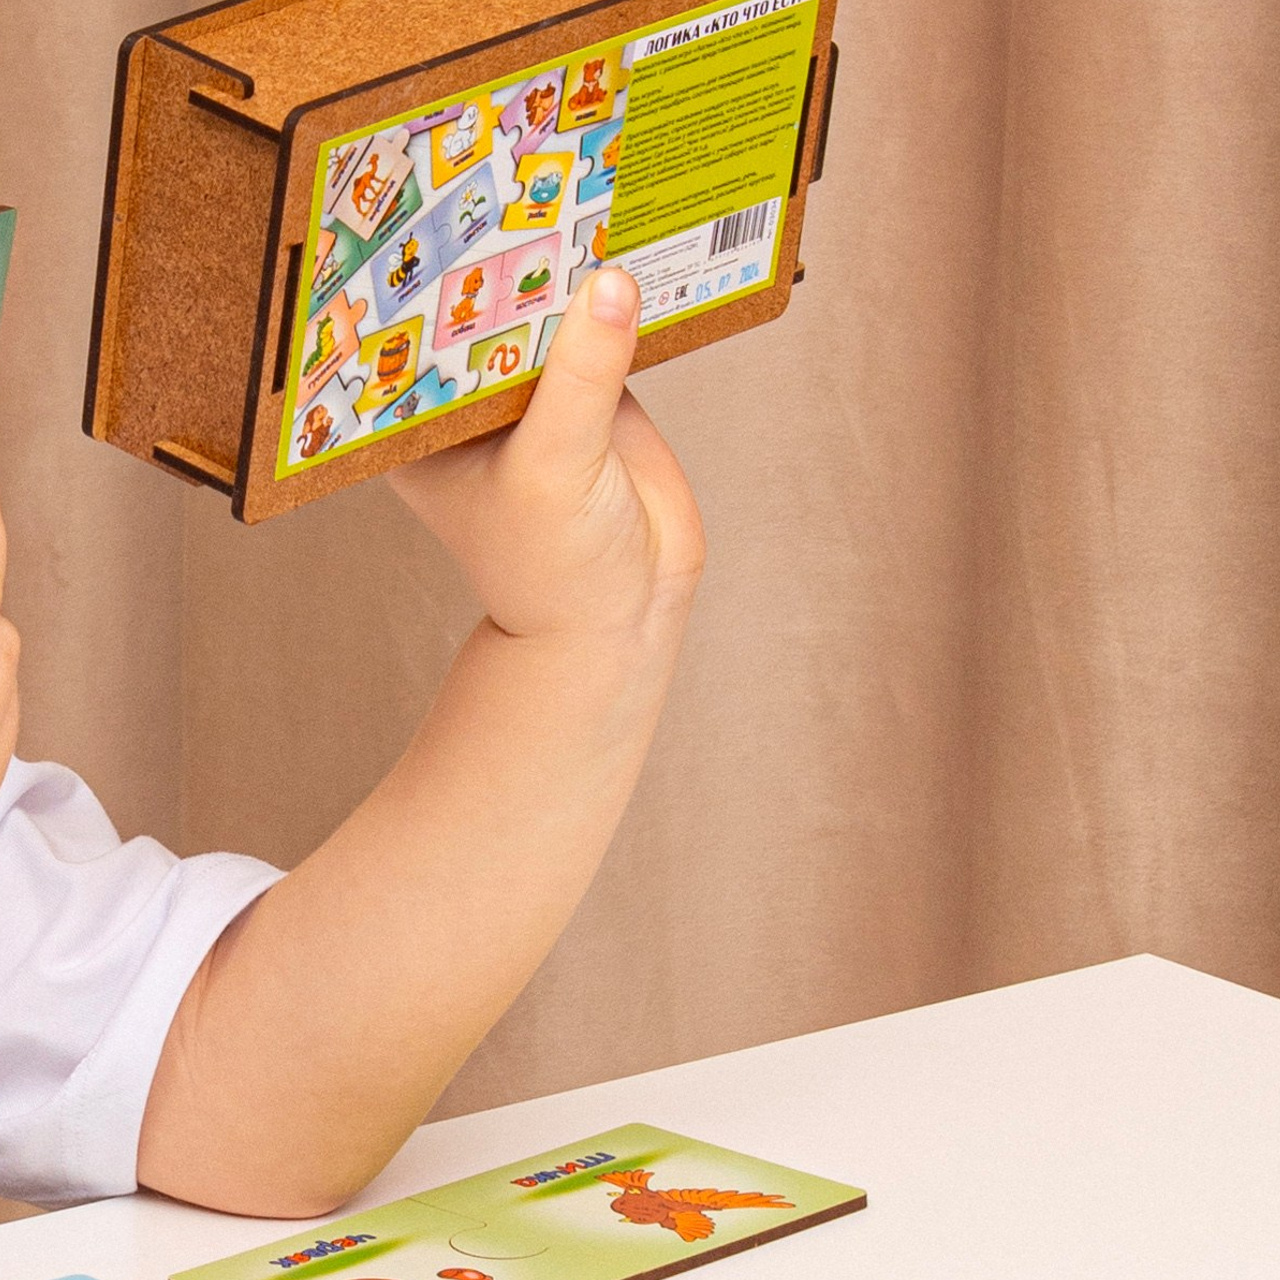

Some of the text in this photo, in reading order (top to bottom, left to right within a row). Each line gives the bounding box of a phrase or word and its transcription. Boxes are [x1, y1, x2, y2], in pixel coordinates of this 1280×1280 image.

[644, 25, 700, 56] ЛОГИКА
[705, 11, 739, 34] «КТО
[742, 0, 769, 20] ЧТО
[510, 1153, 617, 1187] птичка
[269, 1235, 377, 1268] червяк
